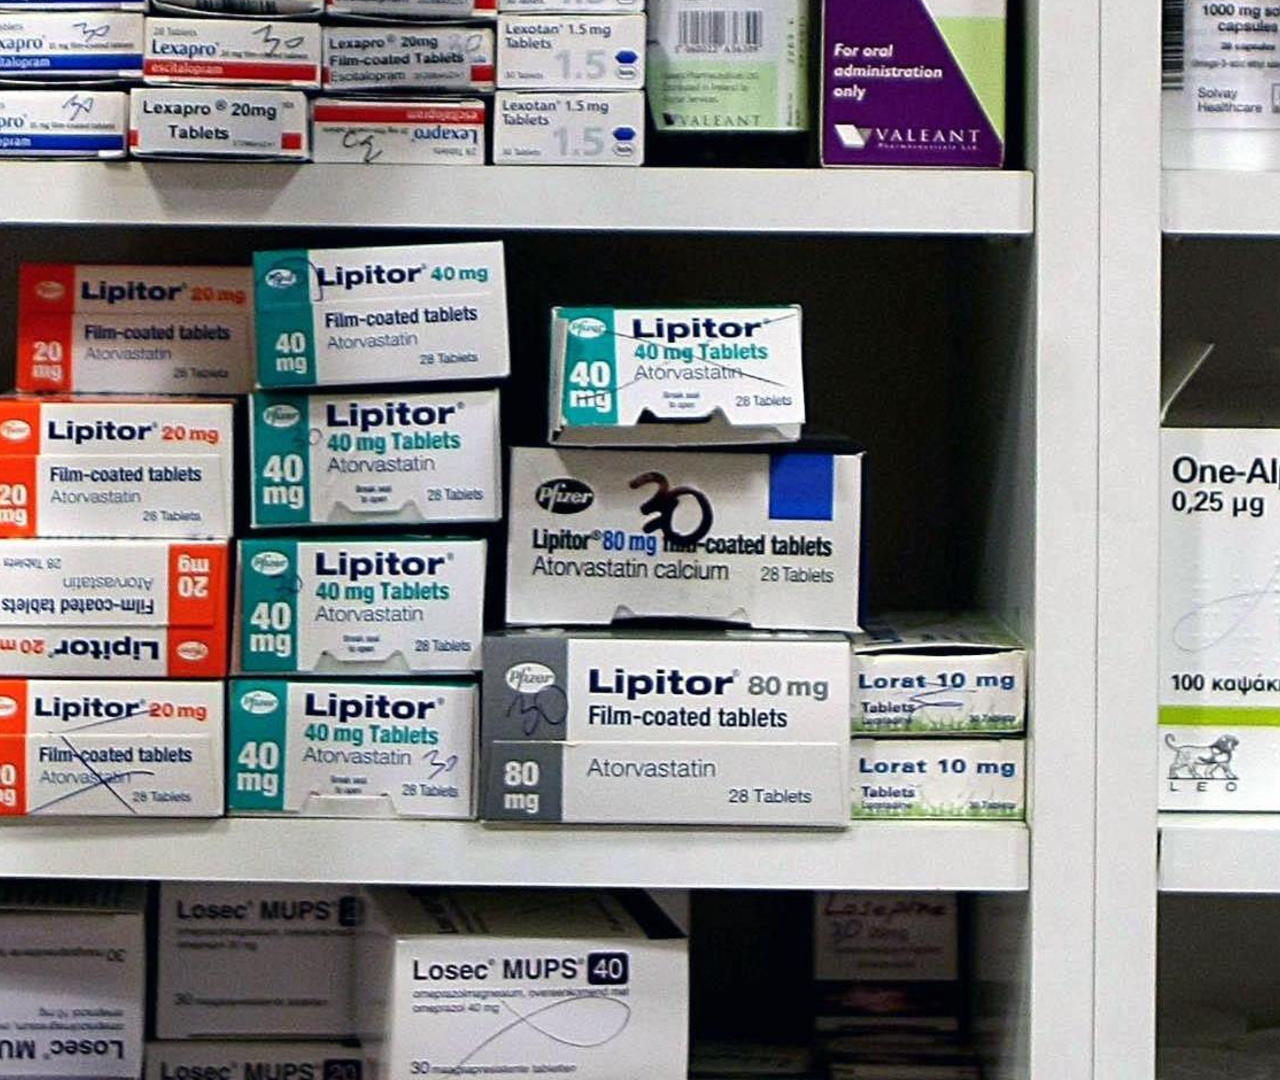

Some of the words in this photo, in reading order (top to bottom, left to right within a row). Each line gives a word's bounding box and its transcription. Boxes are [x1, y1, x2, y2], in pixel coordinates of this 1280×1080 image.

[1202, 5, 1234, 18] 1000
[1239, 8, 1260, 21] mg
[1218, 21, 1278, 35] capsules
[833, 43, 862, 58] For
[866, 43, 893, 58] oral
[833, 64, 943, 79] administration
[833, 84, 866, 101] only
[1197, 87, 1238, 102] Solvay
[1197, 101, 1262, 114] Healthcare
[876, 129, 981, 143] VALEANT
[48, 421, 151, 444] Lipitor
[161, 427, 187, 442] 20
[191, 431, 219, 446] mg
[50, 466, 144, 483] Film-coated
[148, 466, 202, 483] tablets
[50, 488, 141, 504] Atorvastatin
[538, 482, 592, 513] Pfizer
[1172, 491, 1223, 514] 0,25
[1232, 494, 1264, 518] µg
[603, 531, 624, 551] 80
[628, 536, 657, 556] mg
[771, 534, 832, 557] tablets
[316, 552, 446, 577] Lipitor
[532, 557, 648, 578] Atorvastatin
[654, 560, 729, 580] calcium
[760, 566, 780, 582] 28
[781, 567, 834, 584] Tablets
[316, 582, 340, 600] 40
[344, 586, 375, 604] mg
[379, 581, 449, 600] Tablets
[250, 603, 291, 631] 40
[316, 605, 423, 623] Atorvastatin
[249, 633, 292, 658] mg
[589, 669, 733, 699] Lipitor
[748, 677, 780, 696] 80
[787, 681, 829, 702] mg
[1171, 674, 1204, 691] 100
[588, 705, 711, 728] Film-coated
[718, 706, 788, 728] tablets
[504, 761, 540, 787] 80
[587, 758, 716, 778] Atorvastatin
[859, 758, 926, 775] Lorat
[938, 758, 965, 775] 10
[976, 761, 1015, 778] mg
[503, 791, 539, 814] mg
[728, 789, 749, 804] 28
[753, 789, 812, 805] Tablets
[413, 958, 488, 980] Losec
[502, 960, 579, 980] MUPS
[593, 960, 623, 980] 40
